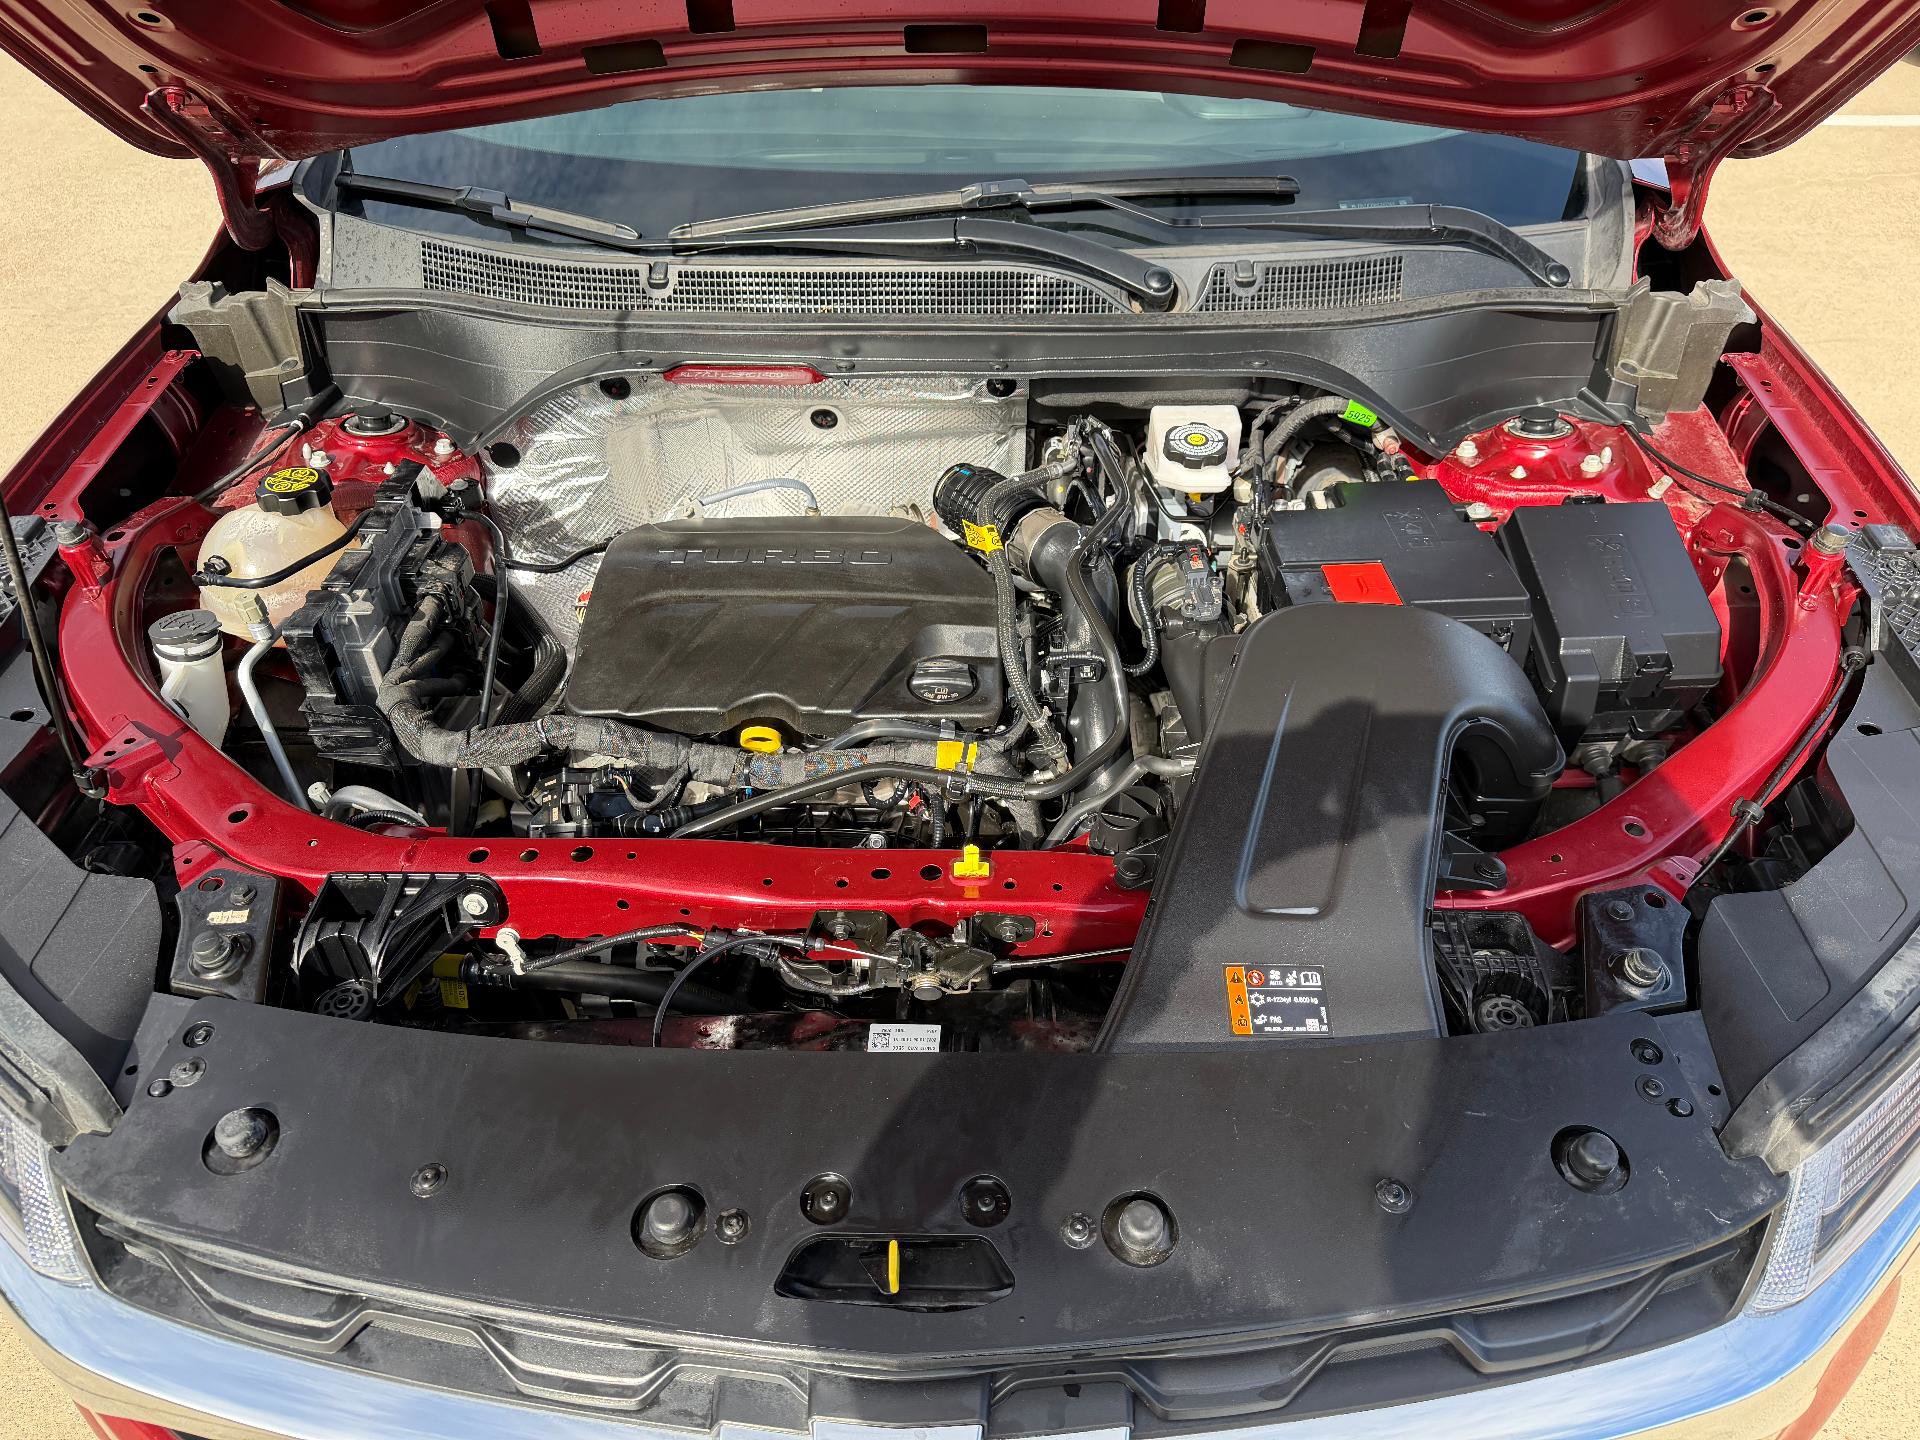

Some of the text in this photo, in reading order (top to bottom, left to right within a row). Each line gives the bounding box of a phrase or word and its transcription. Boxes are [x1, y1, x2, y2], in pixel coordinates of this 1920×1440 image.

[1346, 410, 1372, 424] 5925
[658, 547, 893, 566] TURBO
[1269, 1015, 1283, 1024] PAG
